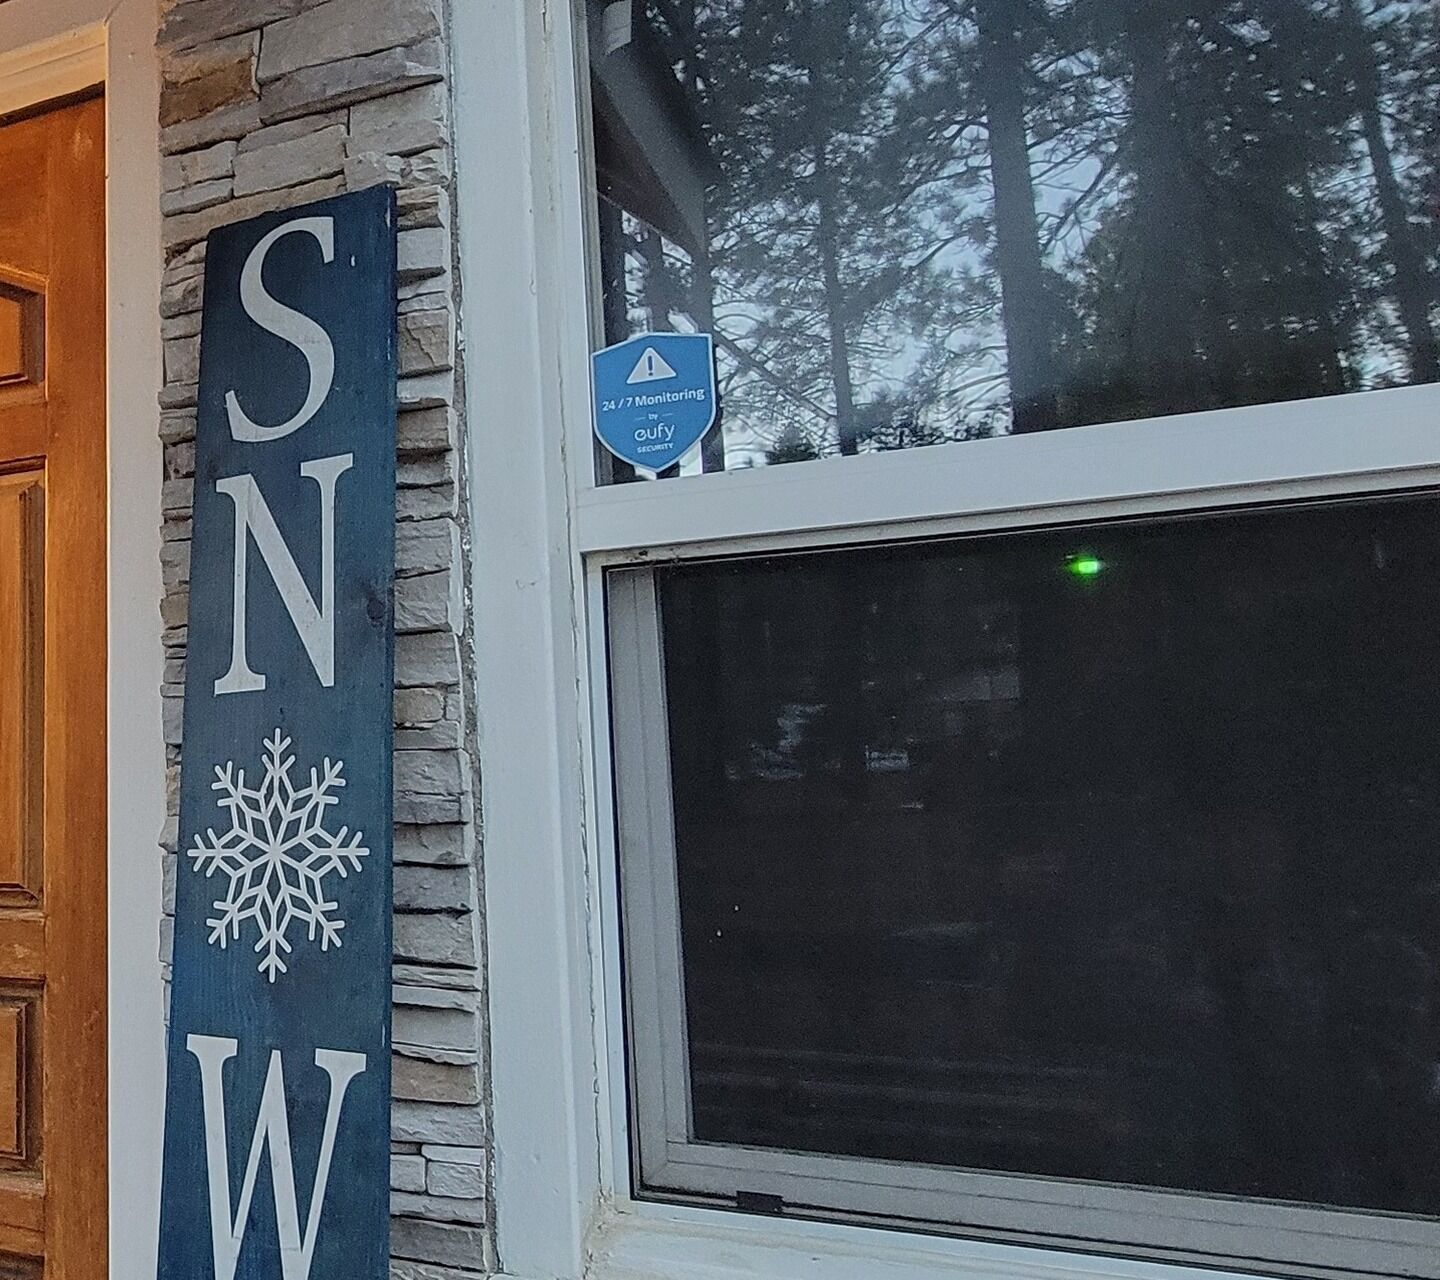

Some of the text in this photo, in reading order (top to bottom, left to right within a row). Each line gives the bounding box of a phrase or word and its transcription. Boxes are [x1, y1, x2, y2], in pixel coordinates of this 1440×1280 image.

[635, 388, 705, 407] Monitoring
[635, 422, 675, 441] eufy
[637, 442, 673, 453] SECURITY
